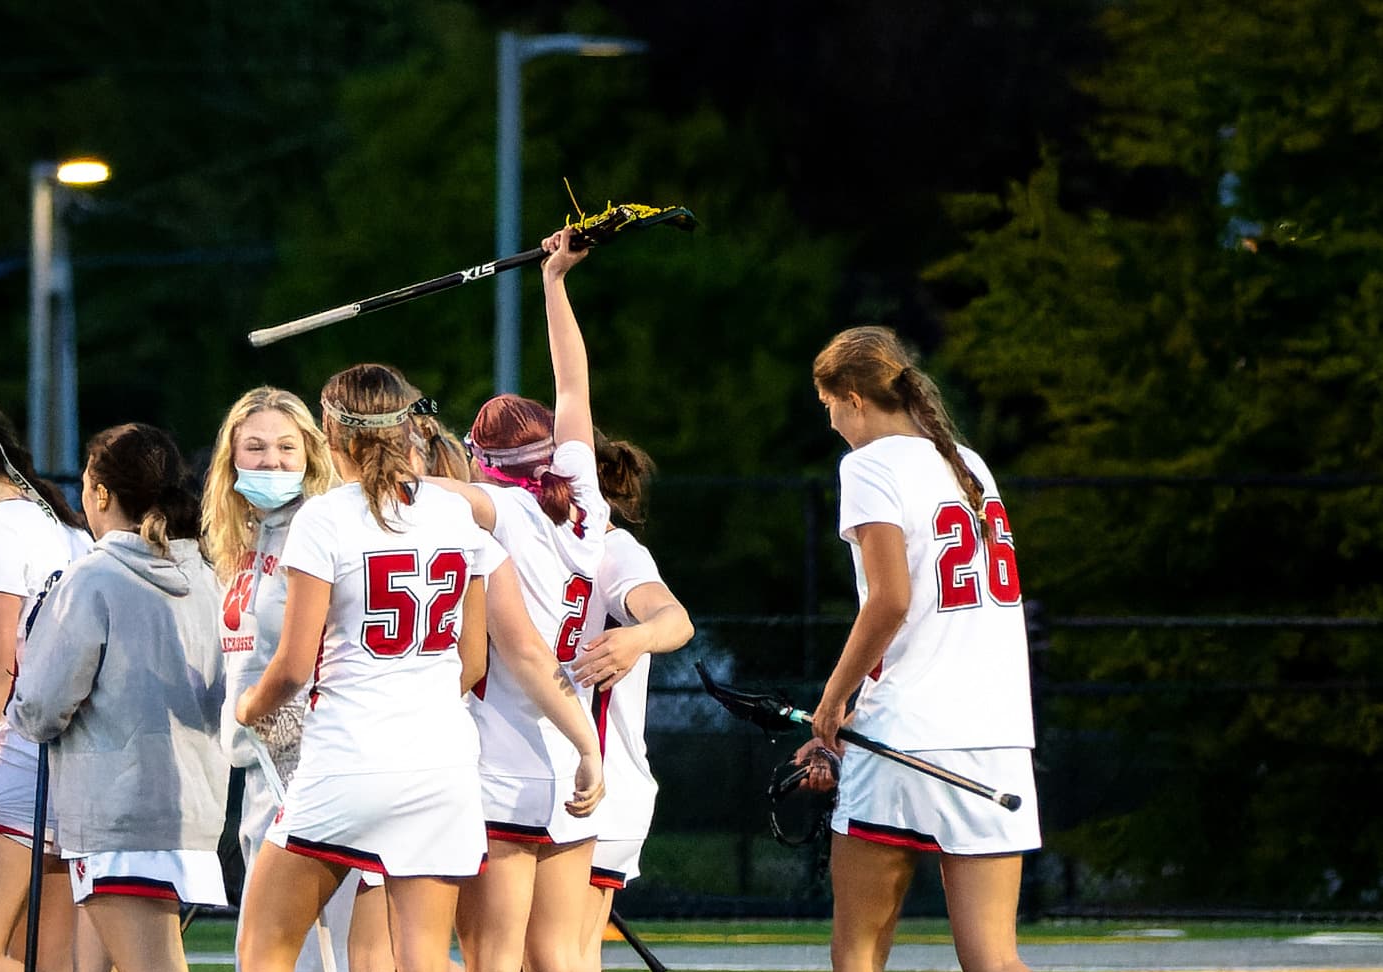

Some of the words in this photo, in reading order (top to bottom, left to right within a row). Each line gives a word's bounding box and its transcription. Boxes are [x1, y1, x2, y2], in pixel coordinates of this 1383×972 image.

[361, 547, 468, 660] 52
[931, 496, 1022, 613] 26
[554, 571, 594, 663] 2
